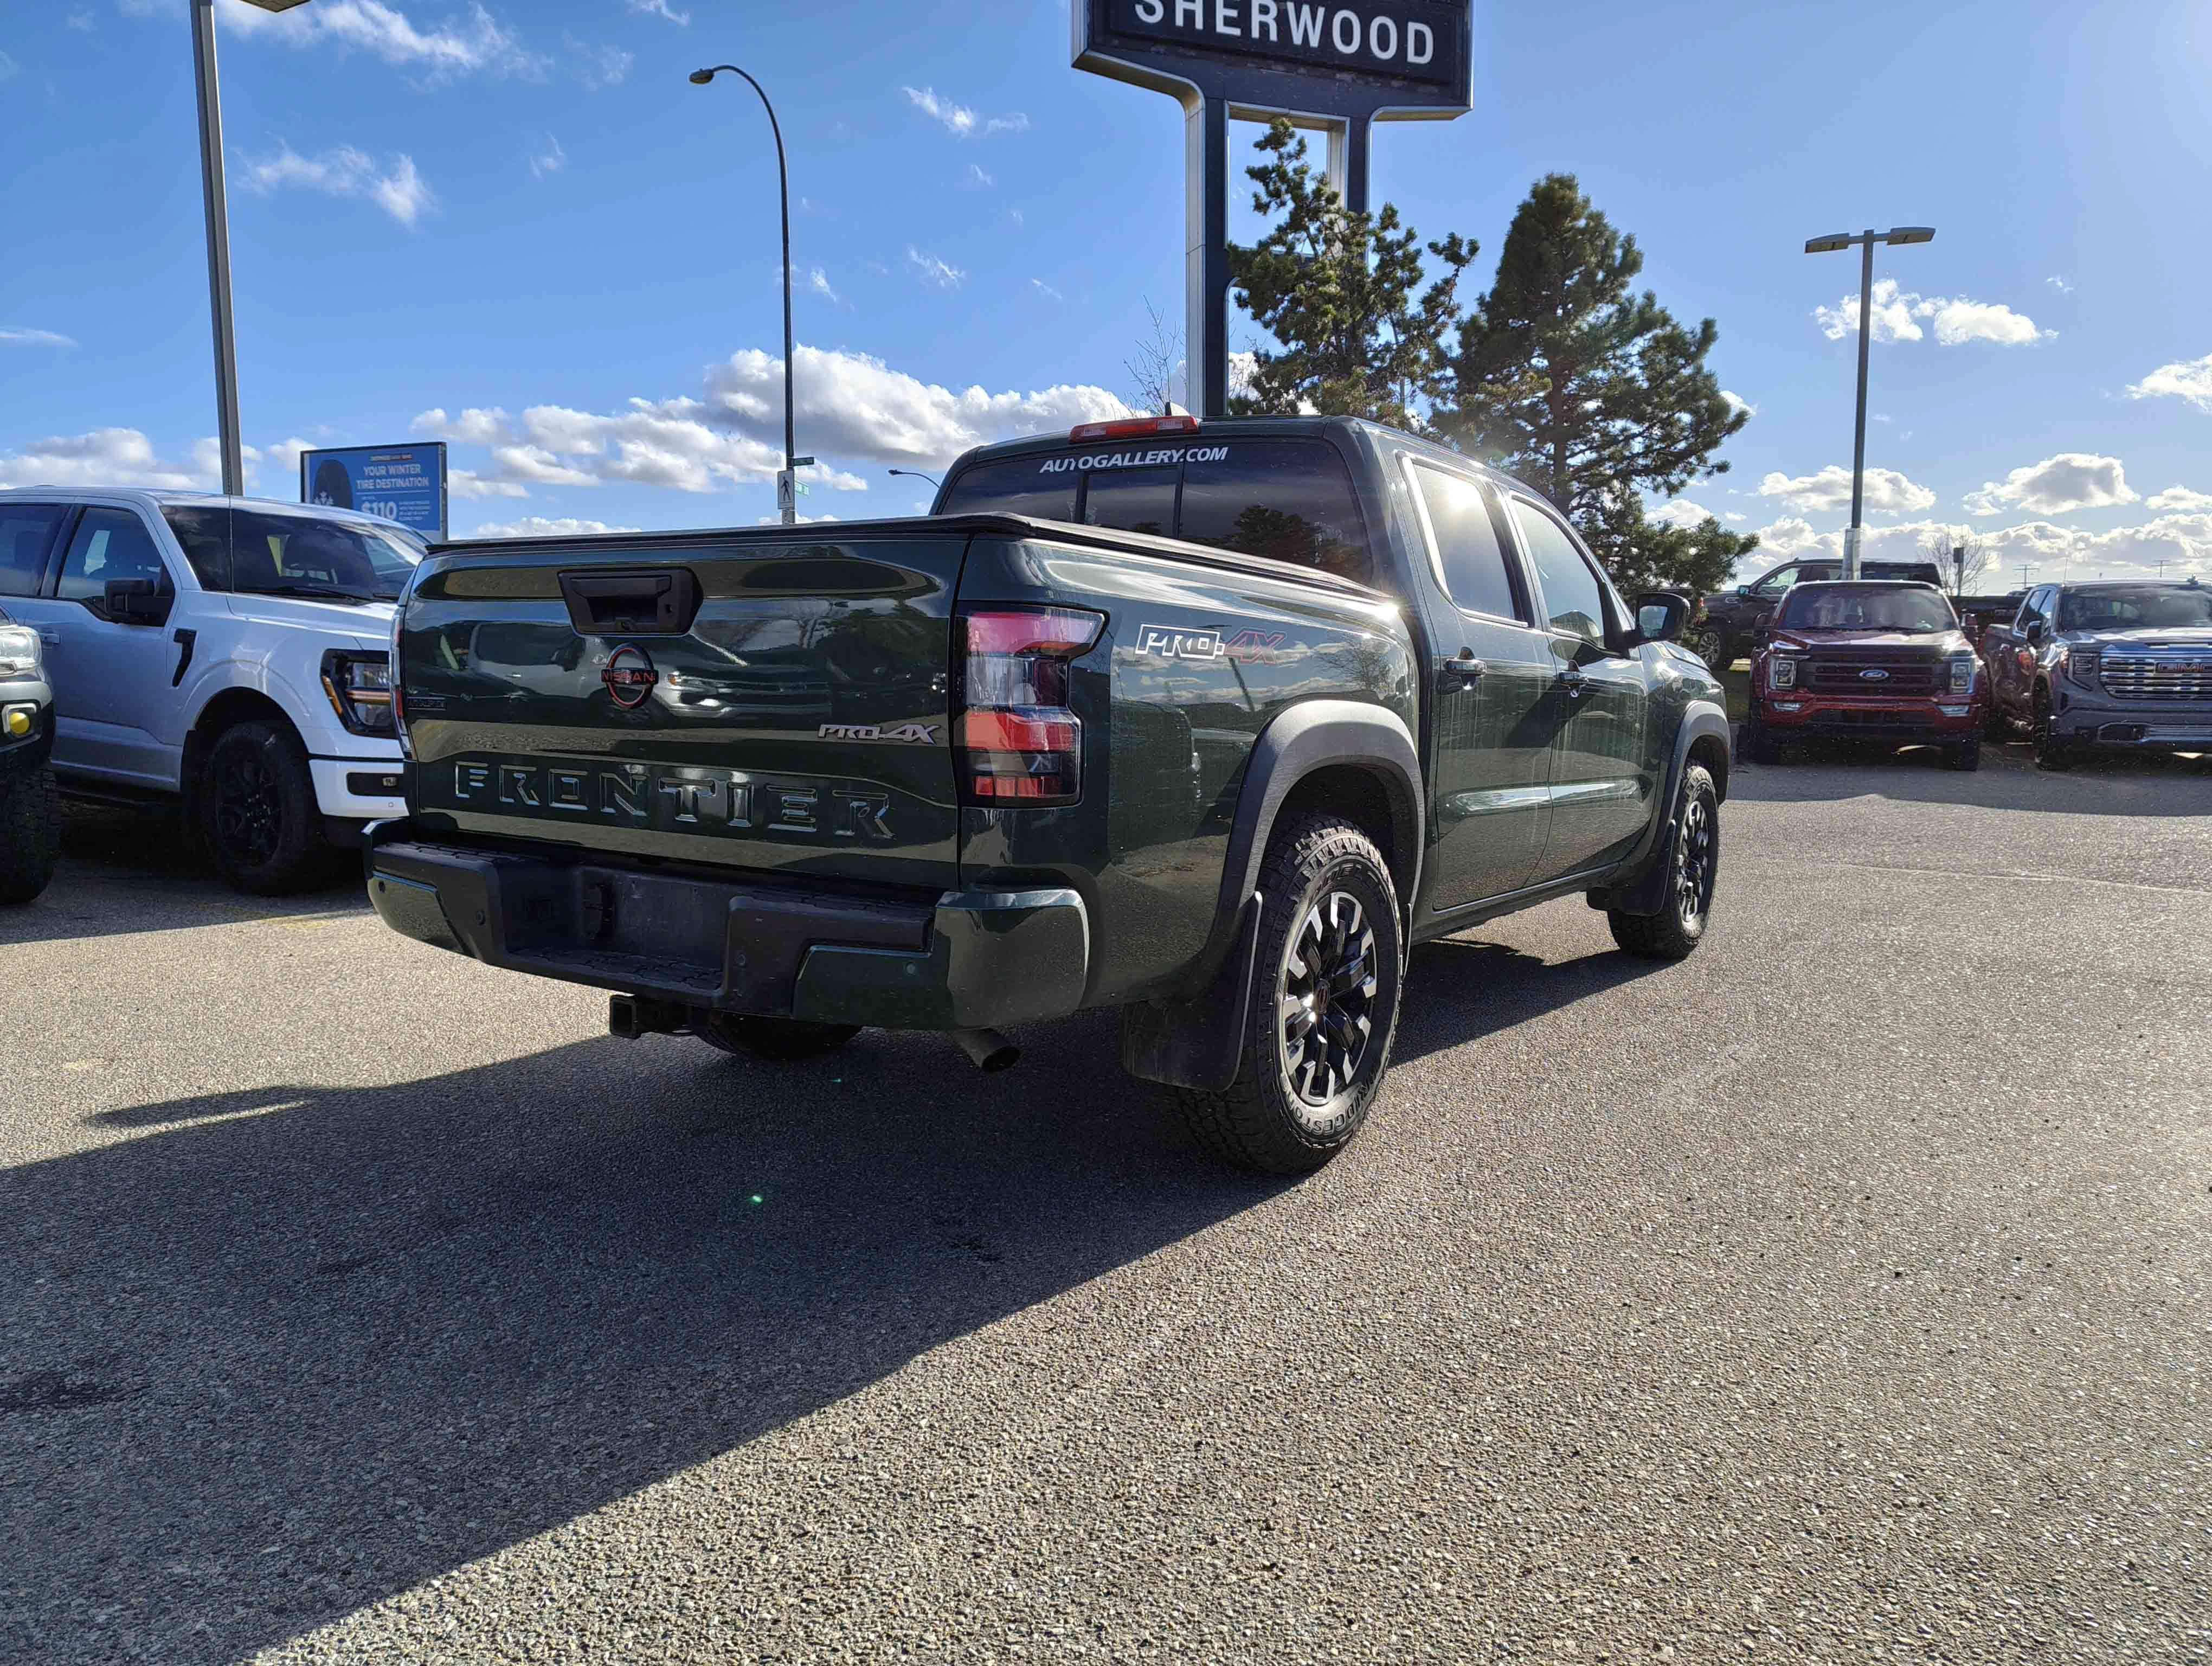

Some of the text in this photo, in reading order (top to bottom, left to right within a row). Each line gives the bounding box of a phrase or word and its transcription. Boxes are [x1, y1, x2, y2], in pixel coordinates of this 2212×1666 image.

[1135, 0, 1434, 65] SHERWOOD
[364, 464, 421, 476] YOUR WINTER
[1039, 446, 1229, 473] AUTOGALLERY.COM
[356, 477, 429, 489] TIRE DESTINATION
[455, 761, 898, 840] FRONTIER
